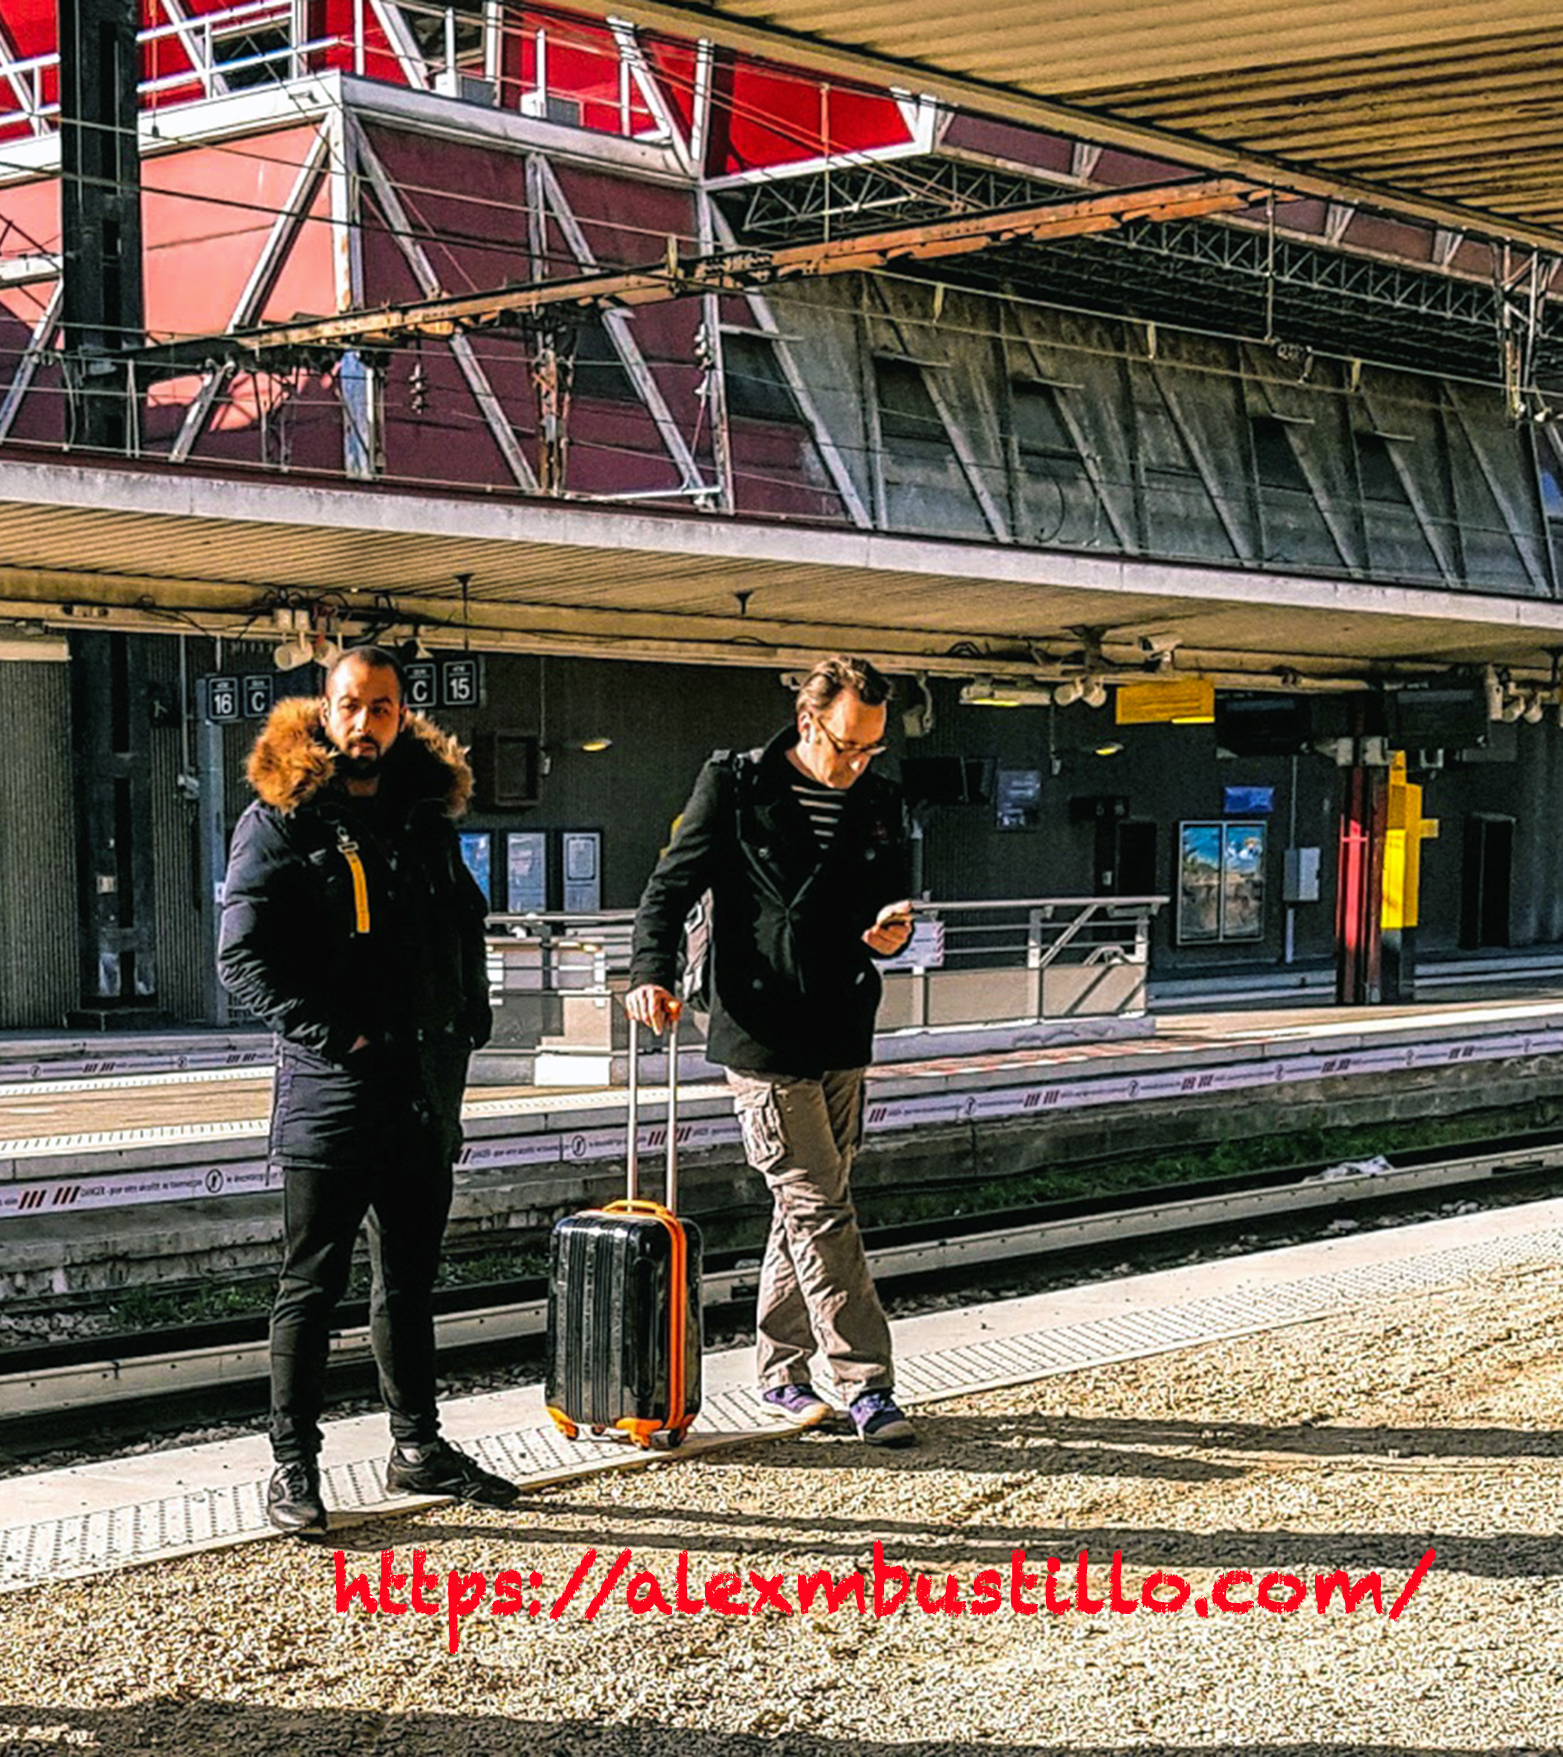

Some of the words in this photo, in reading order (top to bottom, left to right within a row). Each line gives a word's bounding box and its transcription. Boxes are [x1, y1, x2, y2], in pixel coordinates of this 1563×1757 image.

[412, 680, 427, 702] C
[450, 677, 470, 699] 15
[214, 693, 232, 714] 16
[251, 691, 265, 712] C
